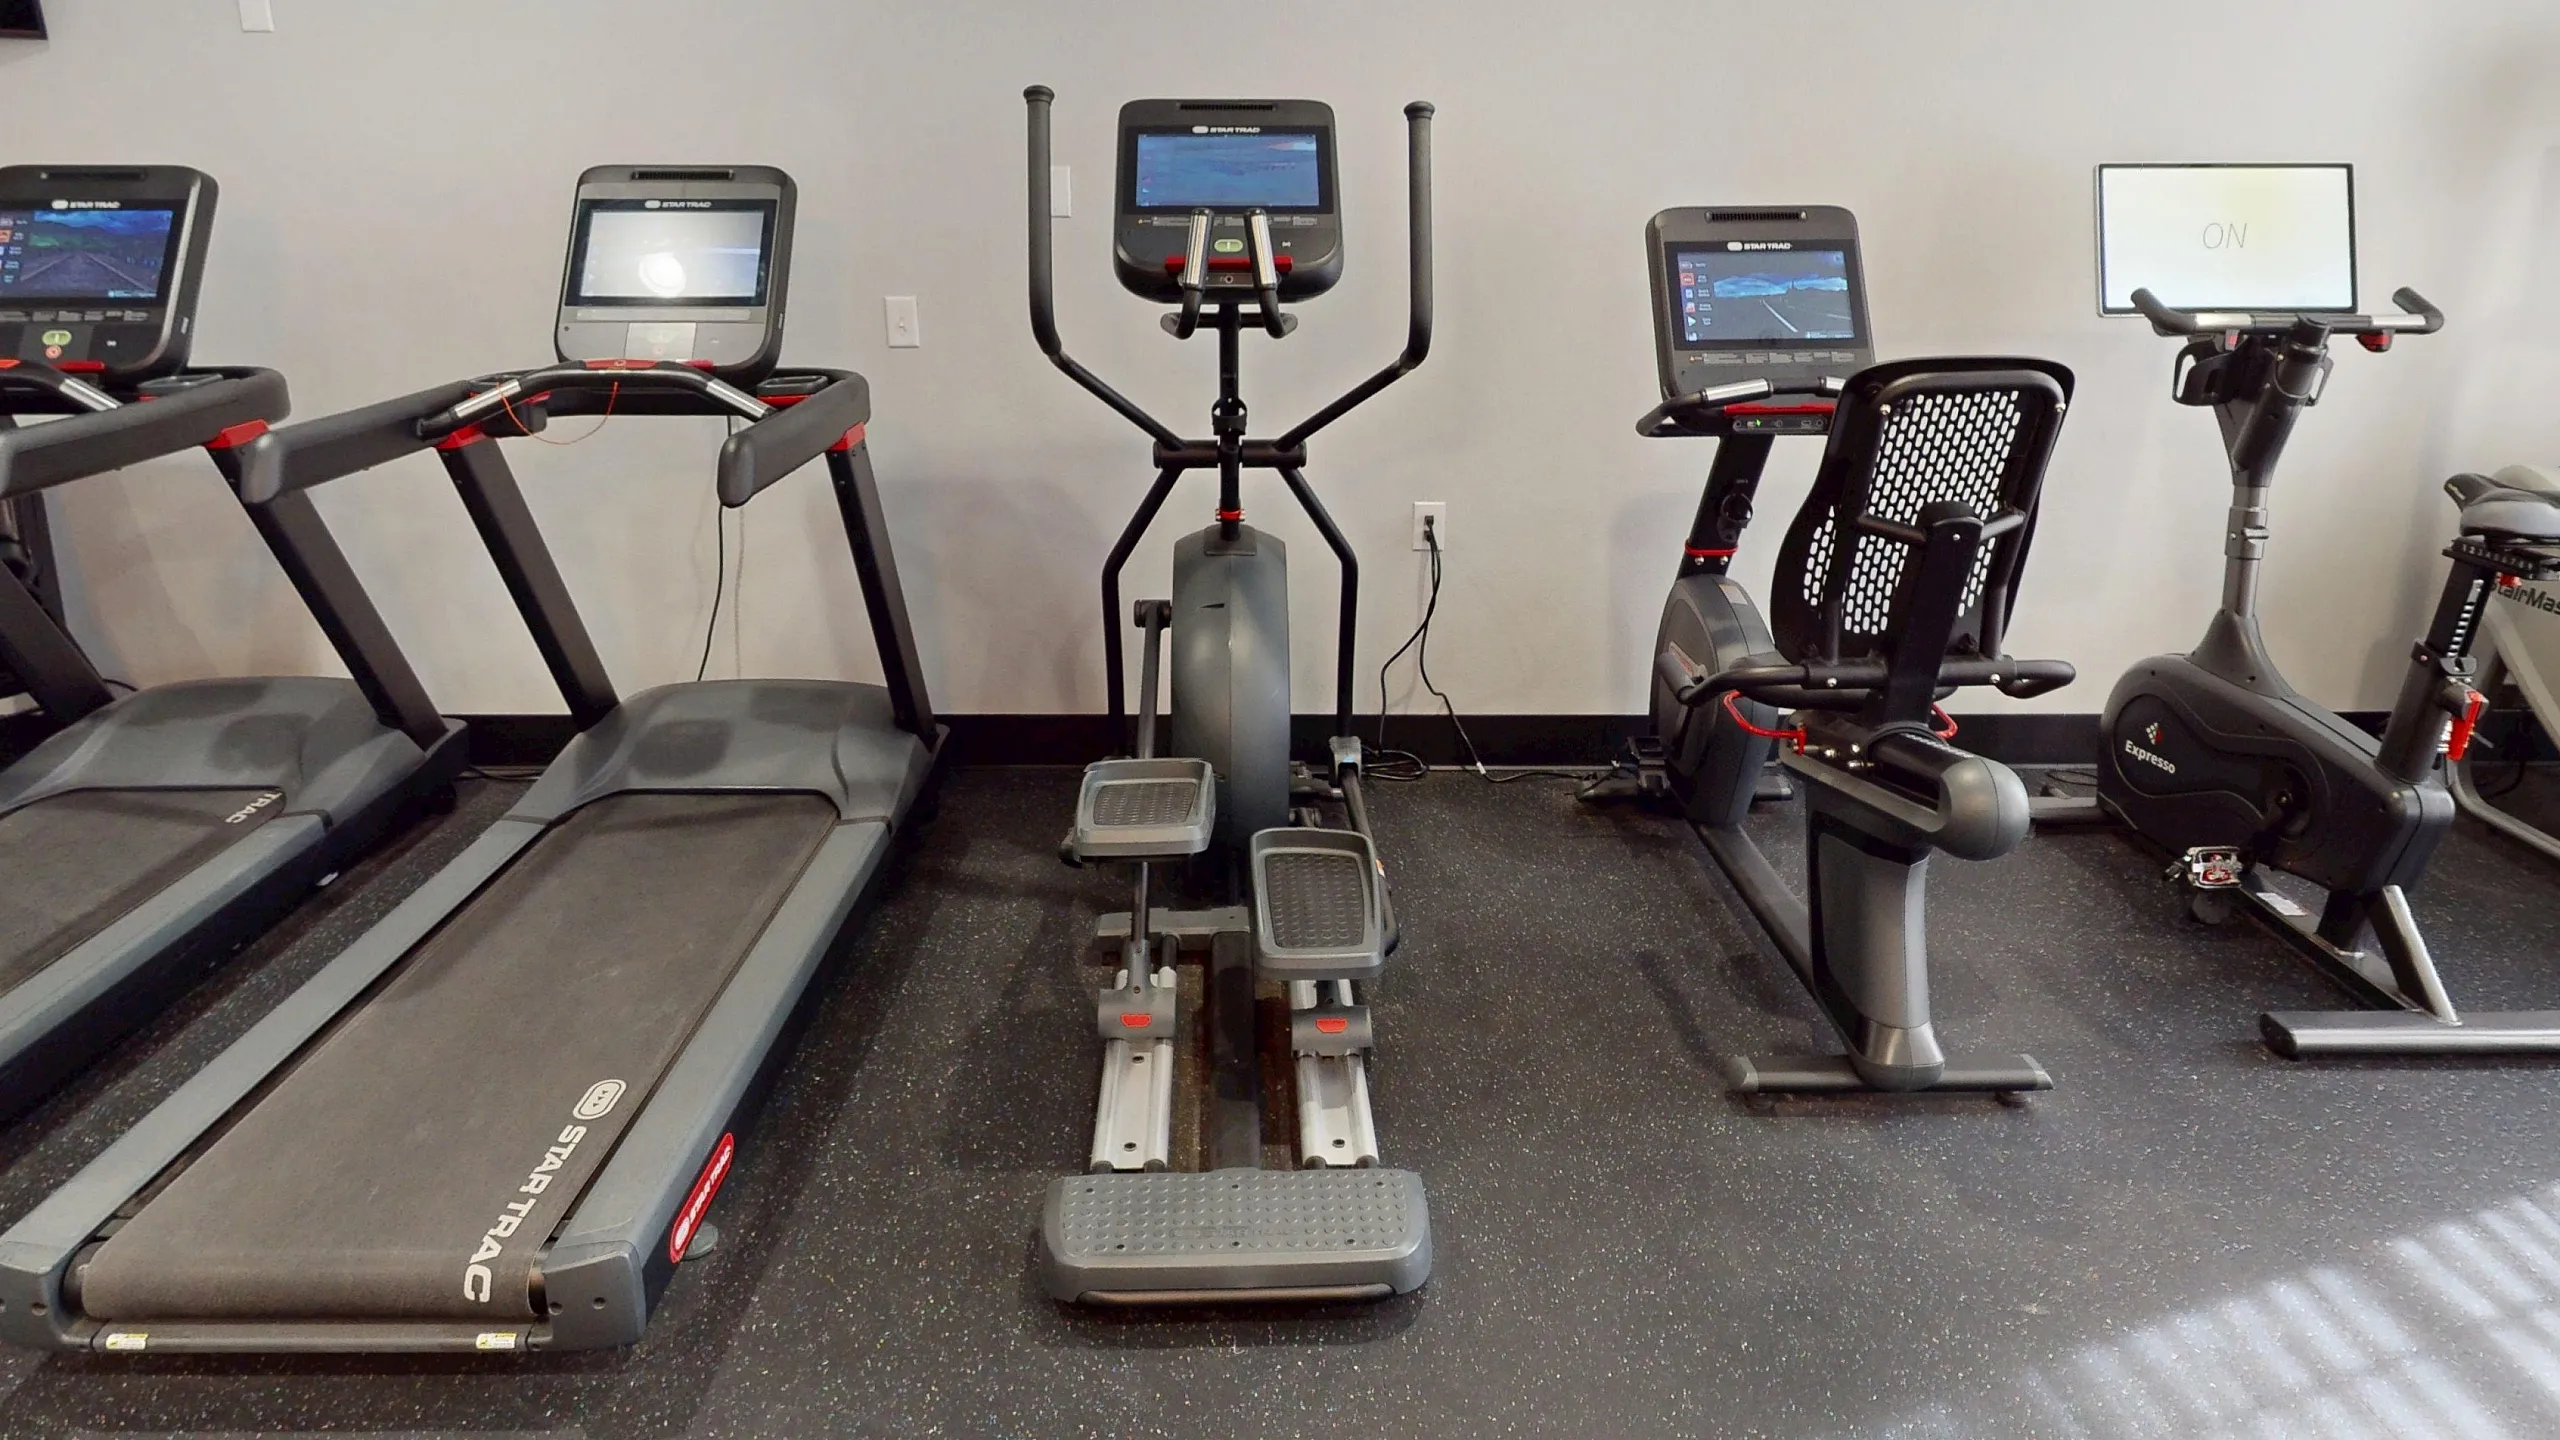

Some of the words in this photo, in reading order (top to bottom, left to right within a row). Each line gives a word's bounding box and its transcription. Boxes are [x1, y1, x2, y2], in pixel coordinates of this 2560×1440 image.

[2202, 222, 2248, 249] ON
[2125, 739, 2176, 774] Expresso
[519, 1124, 587, 1194] STAR
[463, 1198, 537, 1303] TRAC
